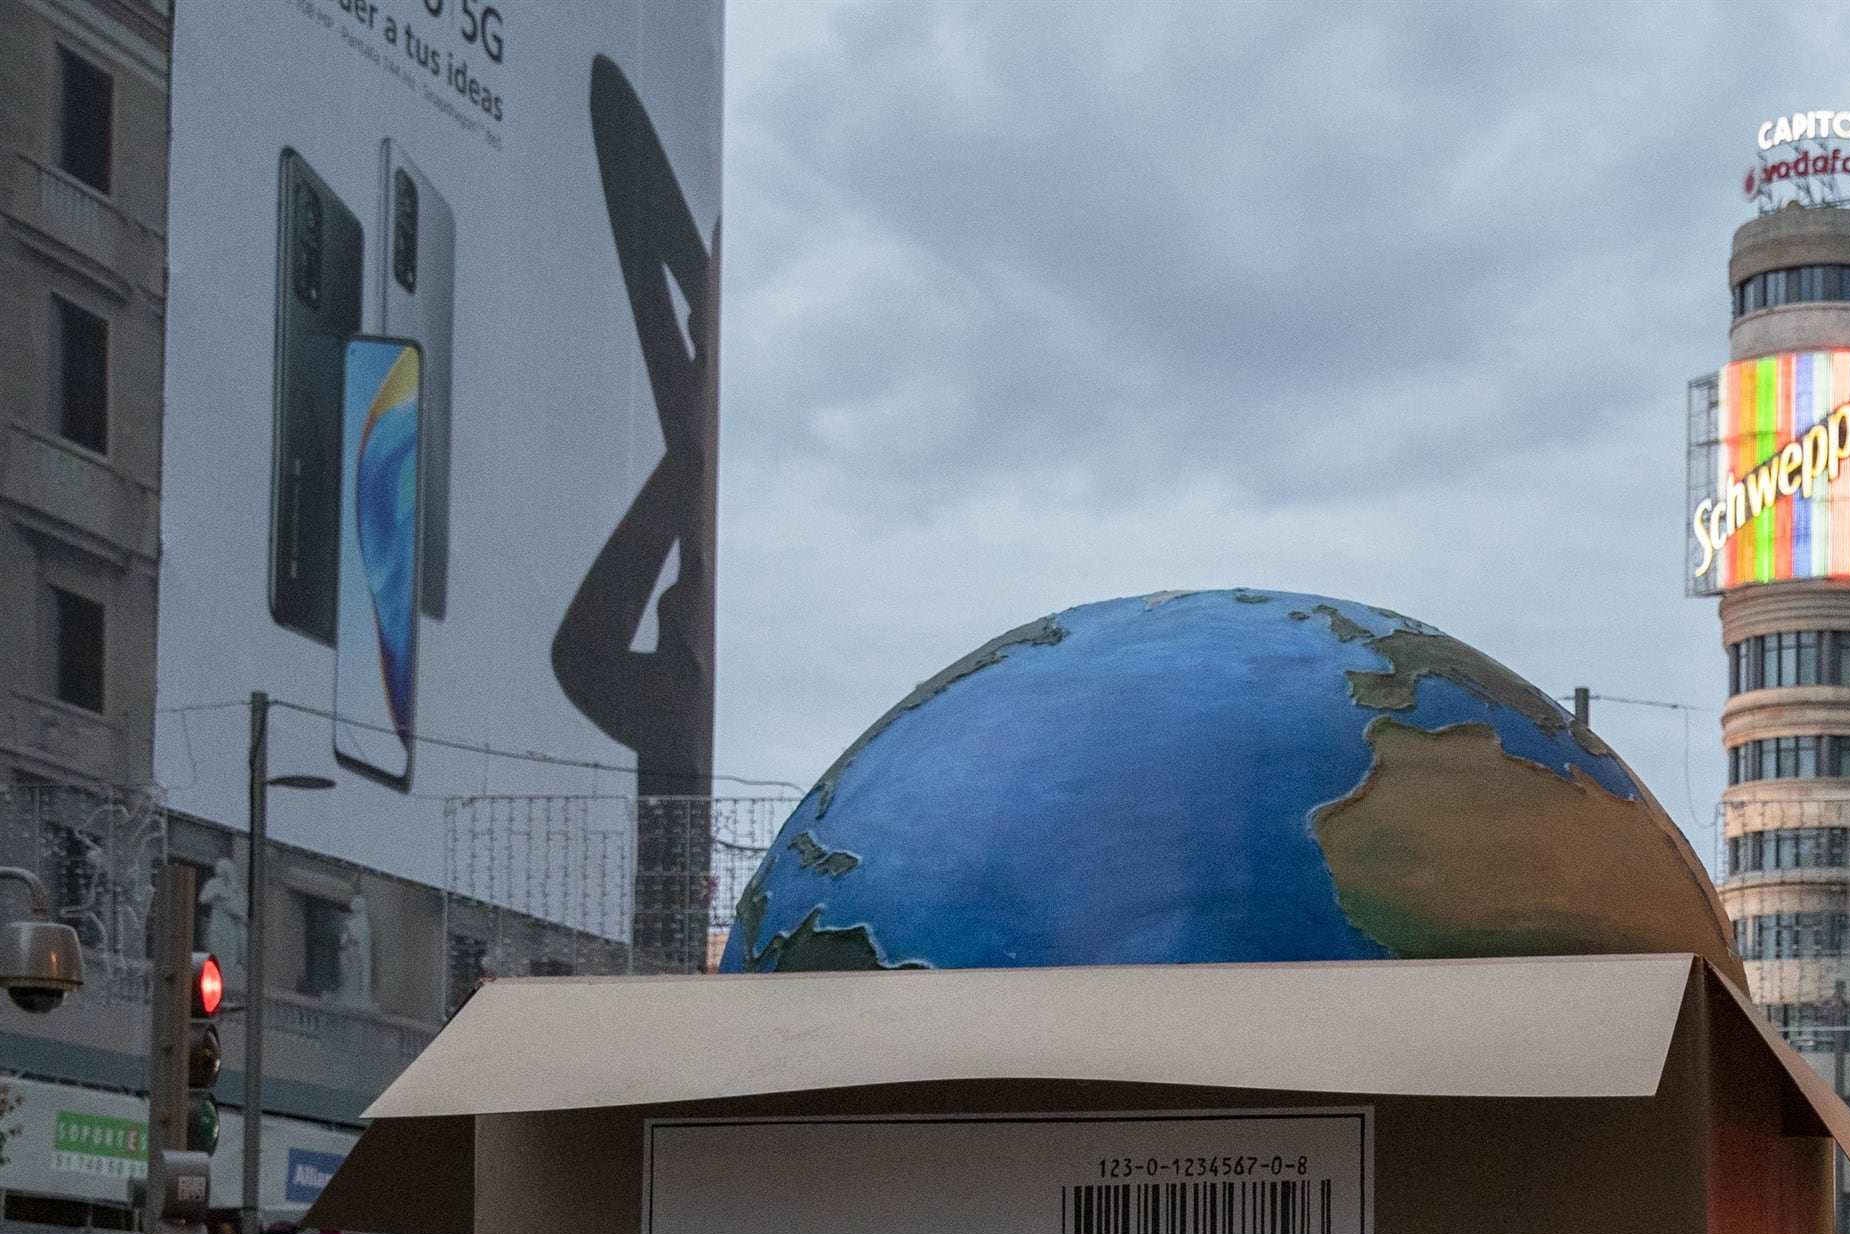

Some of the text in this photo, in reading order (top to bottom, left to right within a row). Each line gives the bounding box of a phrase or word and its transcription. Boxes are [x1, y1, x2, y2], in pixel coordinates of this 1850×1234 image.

[461, 0, 504, 64] 5G
[384, 16, 398, 46] a
[404, 23, 440, 76] tus
[447, 51, 503, 121] ideas
[1099, 1156, 1308, 1178] 123-0-1234567-0-8
